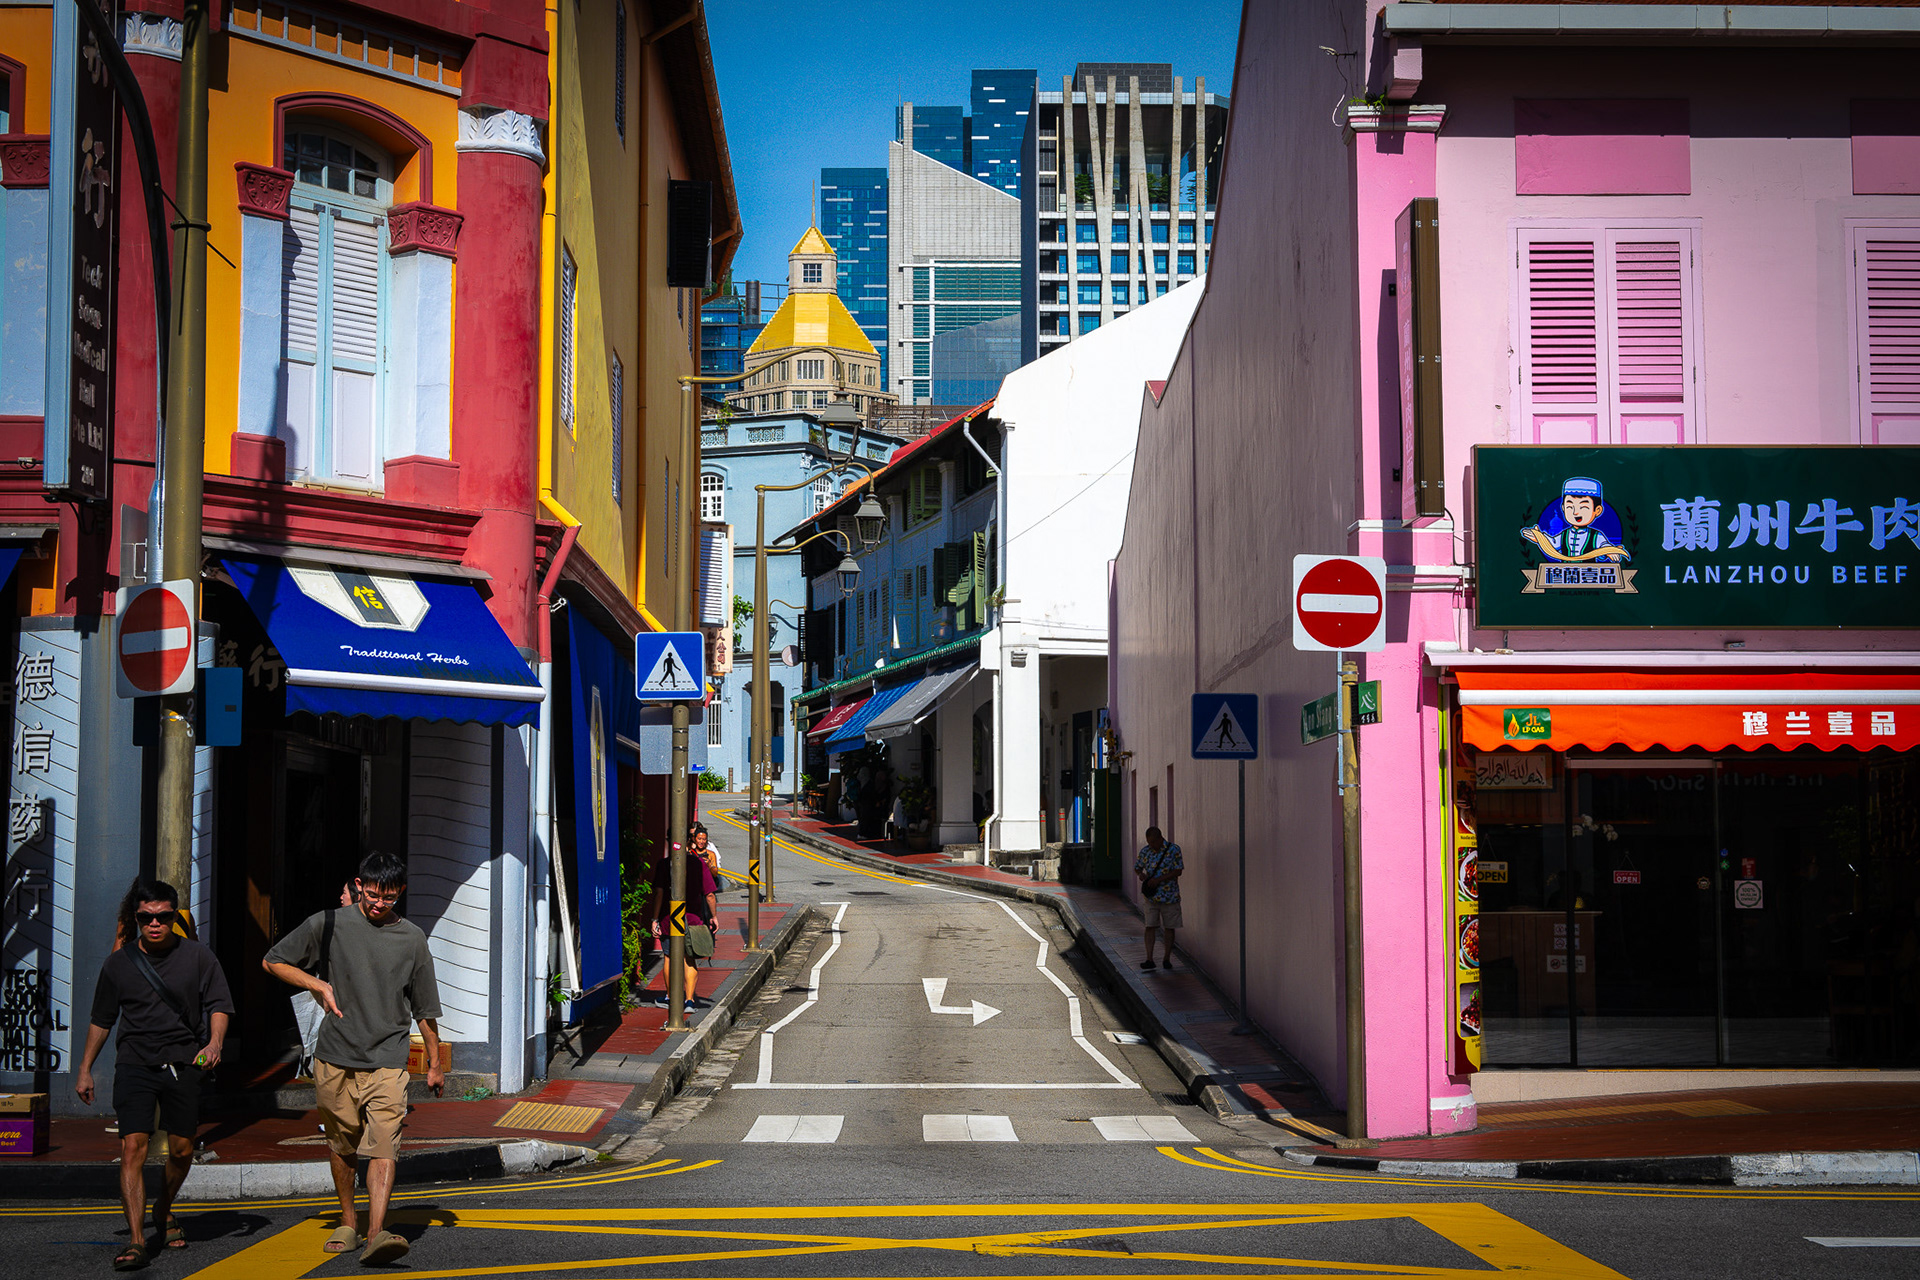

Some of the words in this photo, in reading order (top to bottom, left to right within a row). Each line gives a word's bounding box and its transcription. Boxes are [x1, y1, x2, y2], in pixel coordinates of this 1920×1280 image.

[81, 255, 103, 290] Teck
[73, 331, 106, 371] Medical
[1660, 496, 1920, 552] 蘭州牛肉
[1664, 565, 1810, 584] LANZHOU
[1832, 565, 1908, 584] BEEF
[353, 585, 384, 609] 信
[340, 645, 423, 661] Traditional
[426, 652, 469, 666] Herbs
[1526, 713, 1541, 727] JL
[1742, 711, 1896, 736] 穆兰壹品
[680, 766, 685, 778] 1
[755, 764, 760, 773] 2
[766, 761, 771, 769] 3
[1478, 872, 1506, 881] OPEN
[4, 969, 50, 990] TECK
[4, 989, 49, 1009] SOON
[0, 1009, 69, 1031] EDICAL
